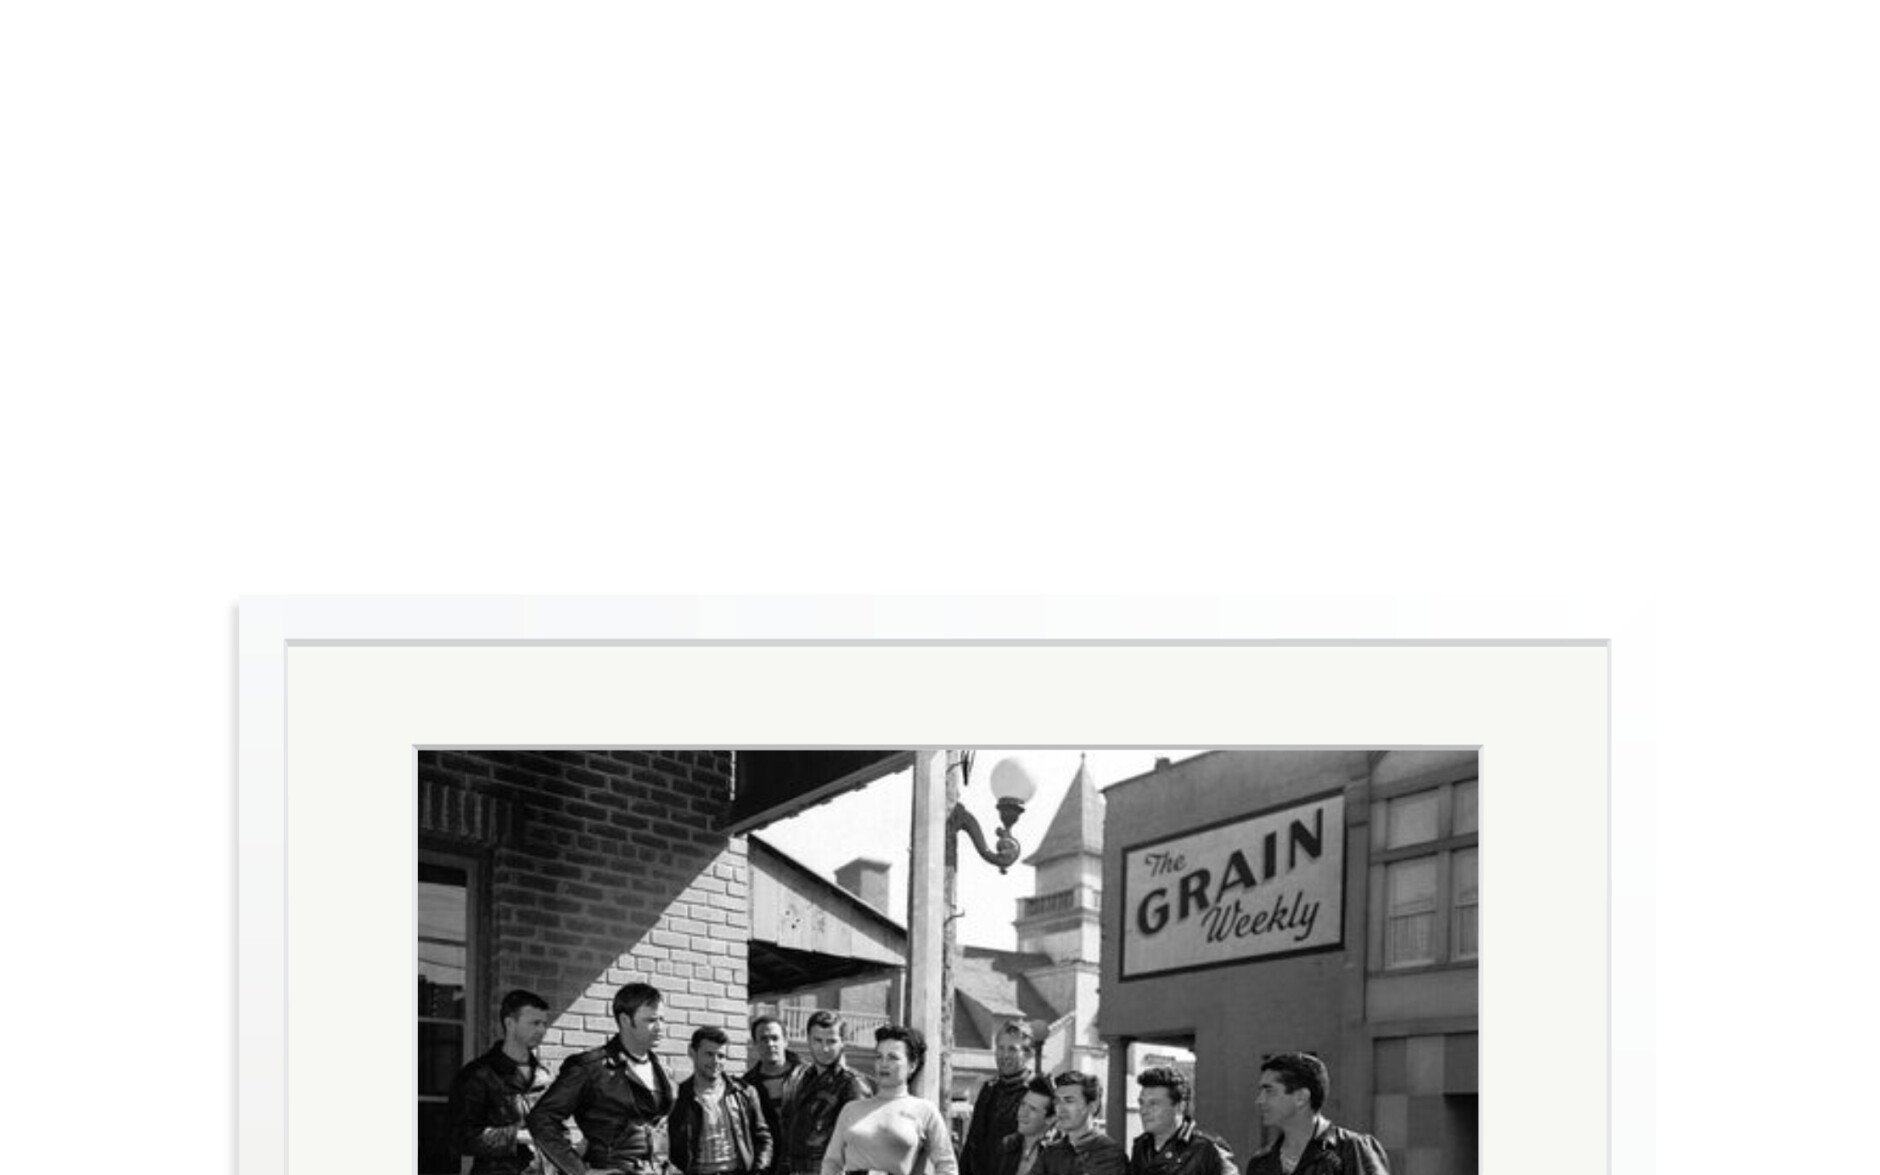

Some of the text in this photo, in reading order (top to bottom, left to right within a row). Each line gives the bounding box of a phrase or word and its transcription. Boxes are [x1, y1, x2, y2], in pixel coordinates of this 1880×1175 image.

[1137, 807, 1323, 936] GRAIN
[1145, 851, 1187, 878] The
[1202, 891, 1320, 943] Weekly
